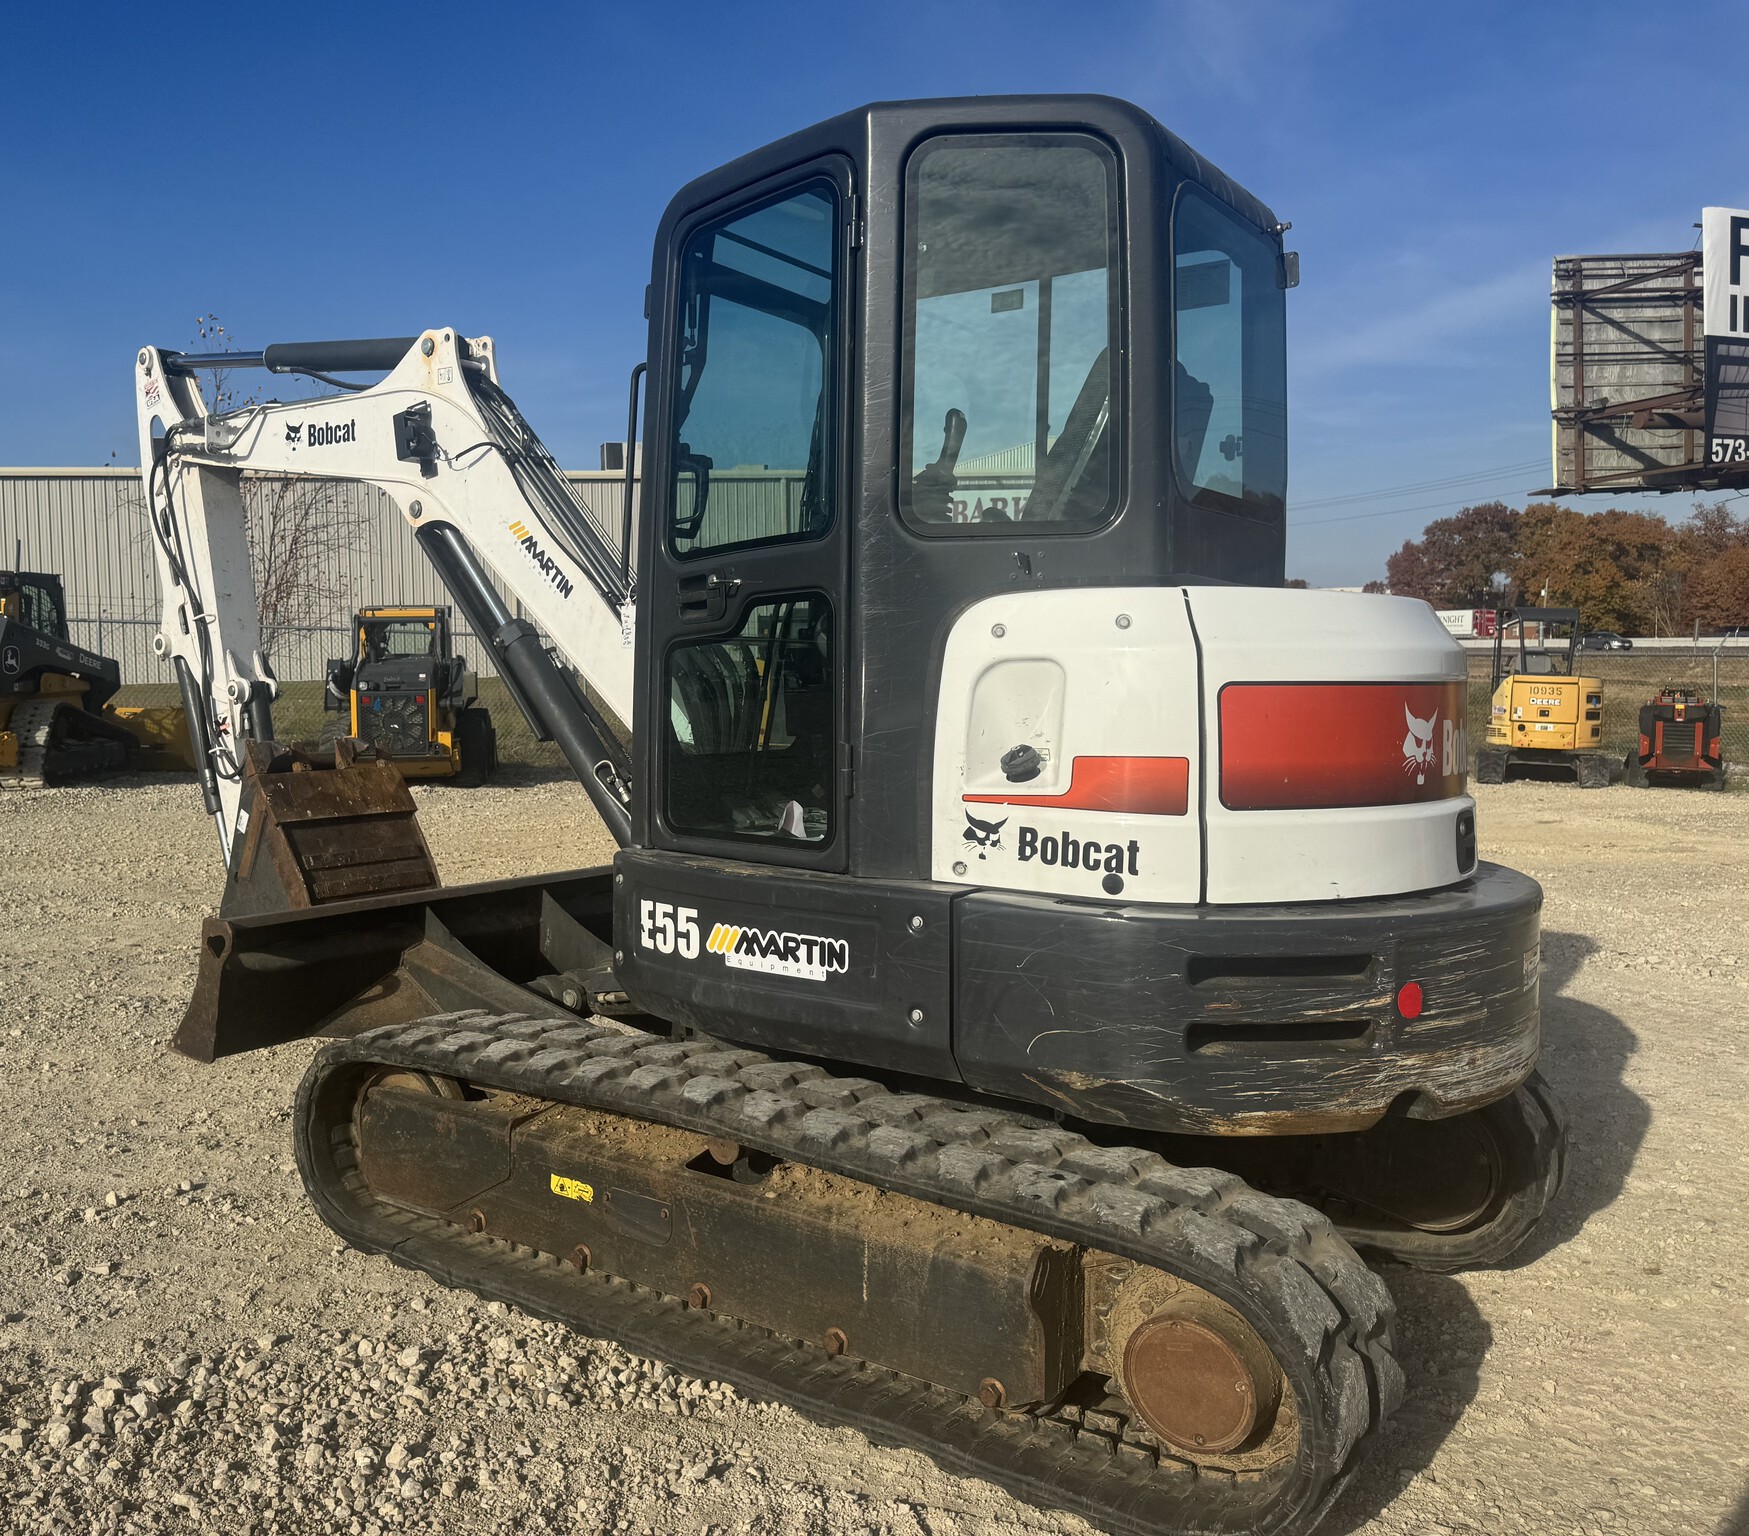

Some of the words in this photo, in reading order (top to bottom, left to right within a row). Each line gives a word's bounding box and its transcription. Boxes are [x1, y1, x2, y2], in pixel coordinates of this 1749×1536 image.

[308, 419, 356, 447] Bobcat
[521, 535, 574, 599] MARTIN
[1441, 615, 1464, 624] NIGHT
[79, 653, 102, 670] DEERE
[1529, 686, 1563, 696] 10935
[1529, 697, 1561, 706] DEERE
[1442, 718, 1467, 776] Bob
[1018, 826, 1140, 876] Bobcat
[640, 899, 700, 960] E55
[734, 929, 846, 970] MARTIN
[726, 954, 826, 978] Equipment
